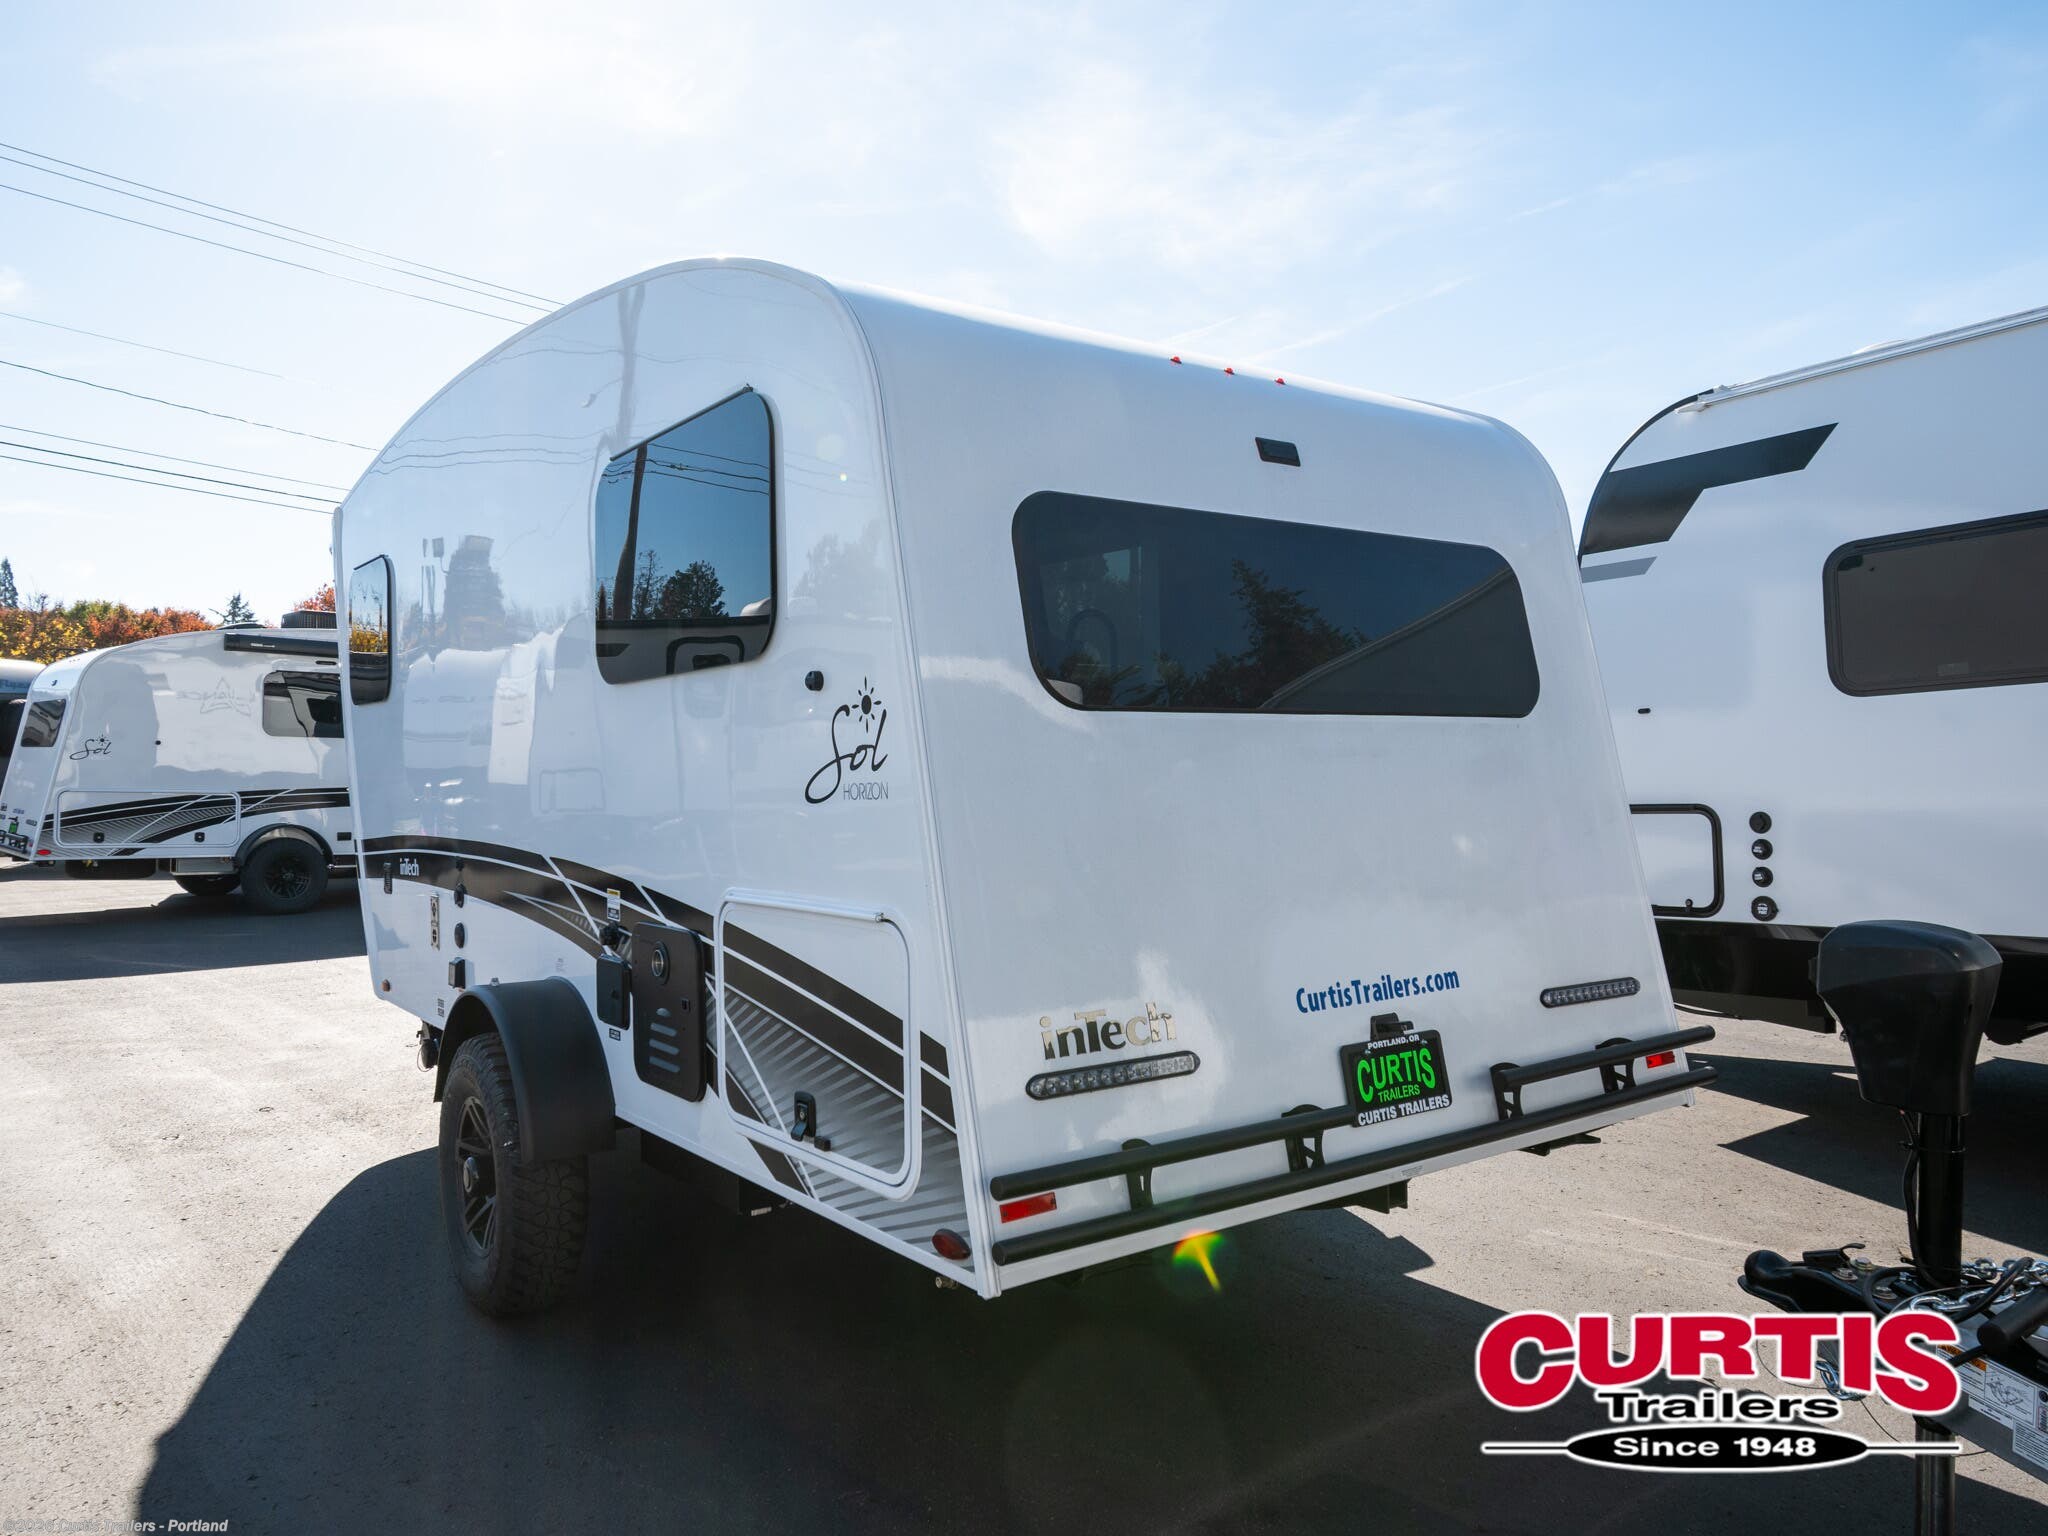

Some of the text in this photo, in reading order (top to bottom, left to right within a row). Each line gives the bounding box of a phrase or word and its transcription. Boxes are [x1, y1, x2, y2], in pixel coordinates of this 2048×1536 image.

[805, 704, 888, 804] Sol
[843, 782, 889, 801] HORIZON
[1296, 970, 1460, 1013] CurtisTrailers.com
[1039, 1001, 1177, 1061] inTech
[1367, 1034, 1420, 1050] PORTLAND, OR
[1357, 1047, 1436, 1103] CURTIS
[1378, 1083, 1421, 1103] TRAILERS
[1358, 1094, 1450, 1127] CURTIS TRAILERS
